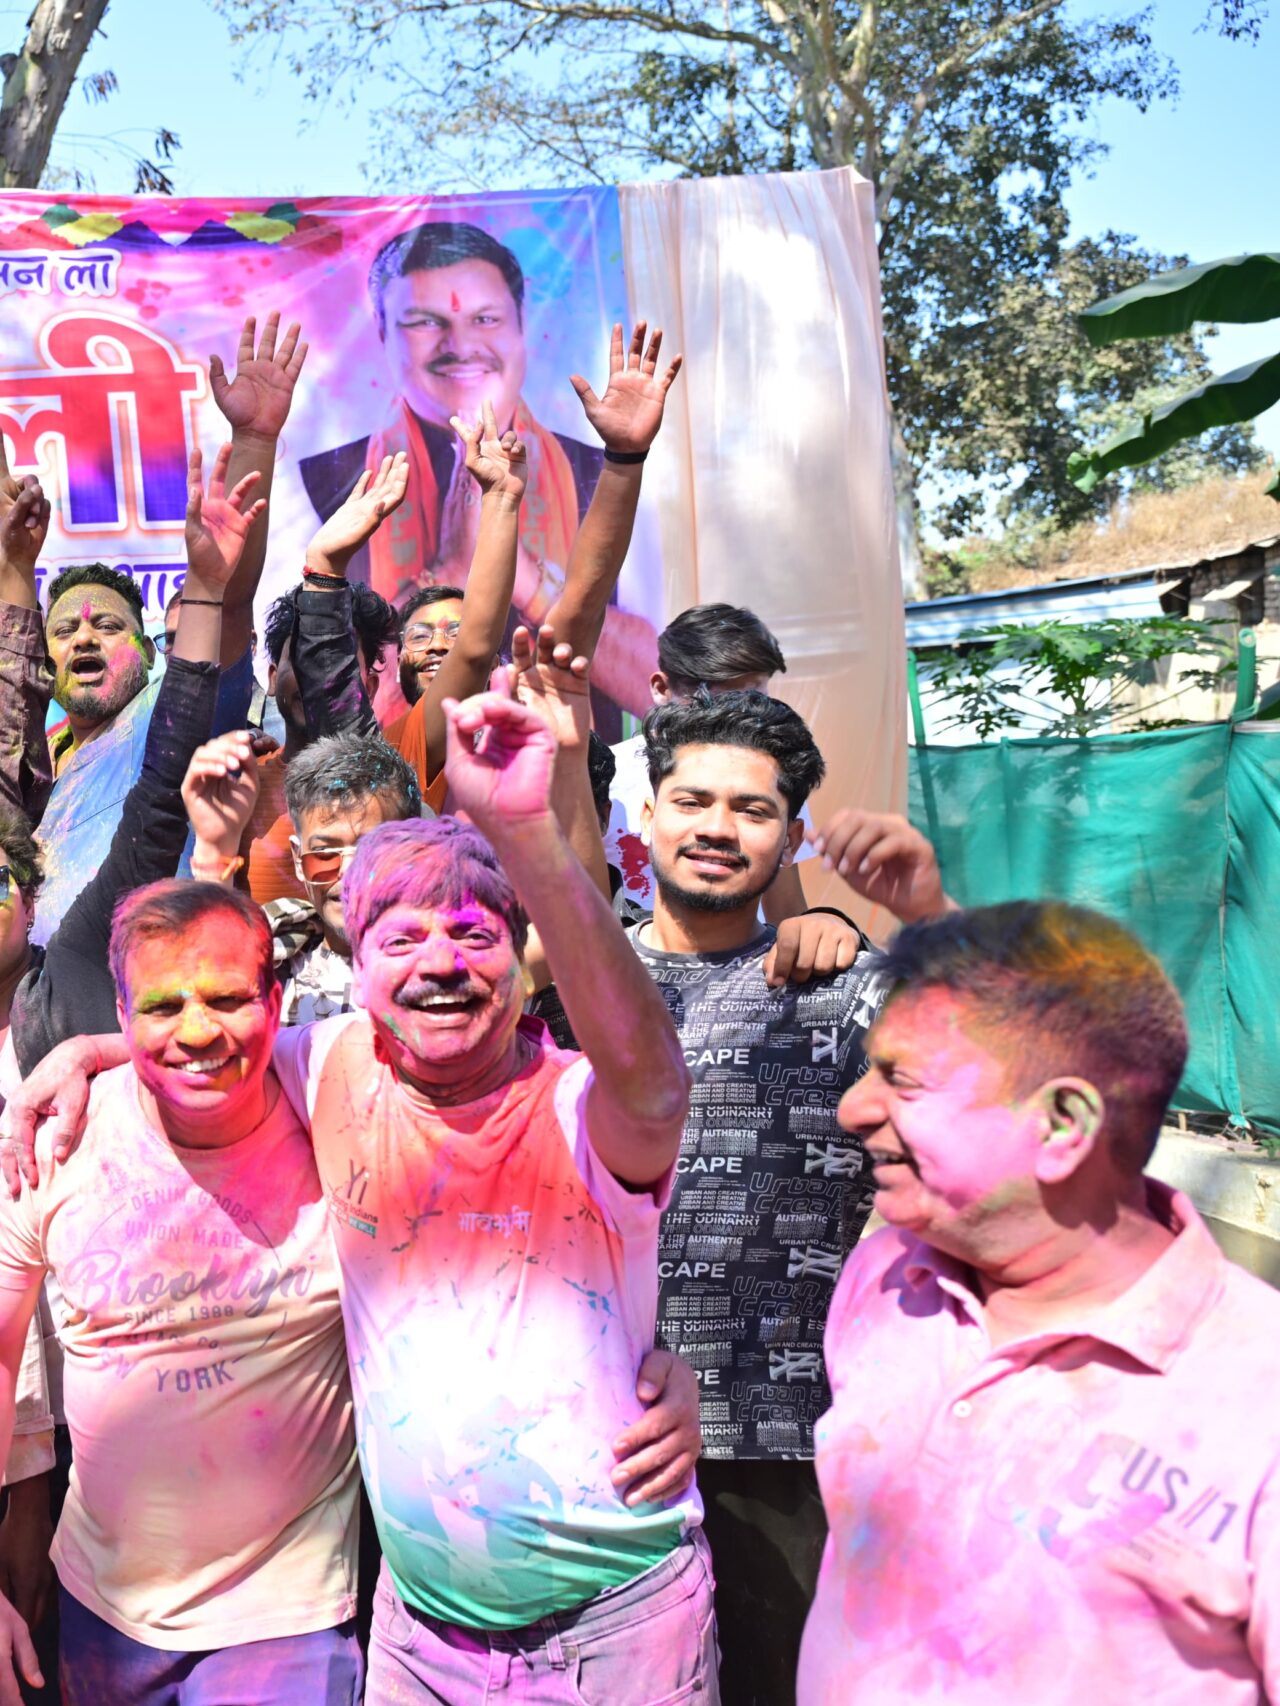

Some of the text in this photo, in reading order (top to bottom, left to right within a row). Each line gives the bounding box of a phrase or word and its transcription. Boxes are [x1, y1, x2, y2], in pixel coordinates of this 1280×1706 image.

[59, 255, 115, 291] ला
[712, 1022, 767, 1031] AUTHENTIC
[683, 1048, 751, 1067] CAPE
[758, 1063, 840, 1086] Urba
[765, 1085, 841, 1108] Crea
[789, 1106, 838, 1117] AUTHENT
[701, 1129, 758, 1139] AUTHENTIC
[795, 1133, 823, 1141] URBAN
[676, 1156, 743, 1173] CAPE
[753, 1194, 841, 1219] Creat
[775, 1213, 829, 1224] AUTHENTIC
[687, 1235, 743, 1245] AUTHENTIC
[657, 1261, 726, 1278] CAPE
[63, 1249, 313, 1318] Brooklyn
[679, 1342, 732, 1353] AUTHENTIC
[155, 1359, 237, 1393] YORK
[756, 1421, 799, 1430] AUTHENTIC
